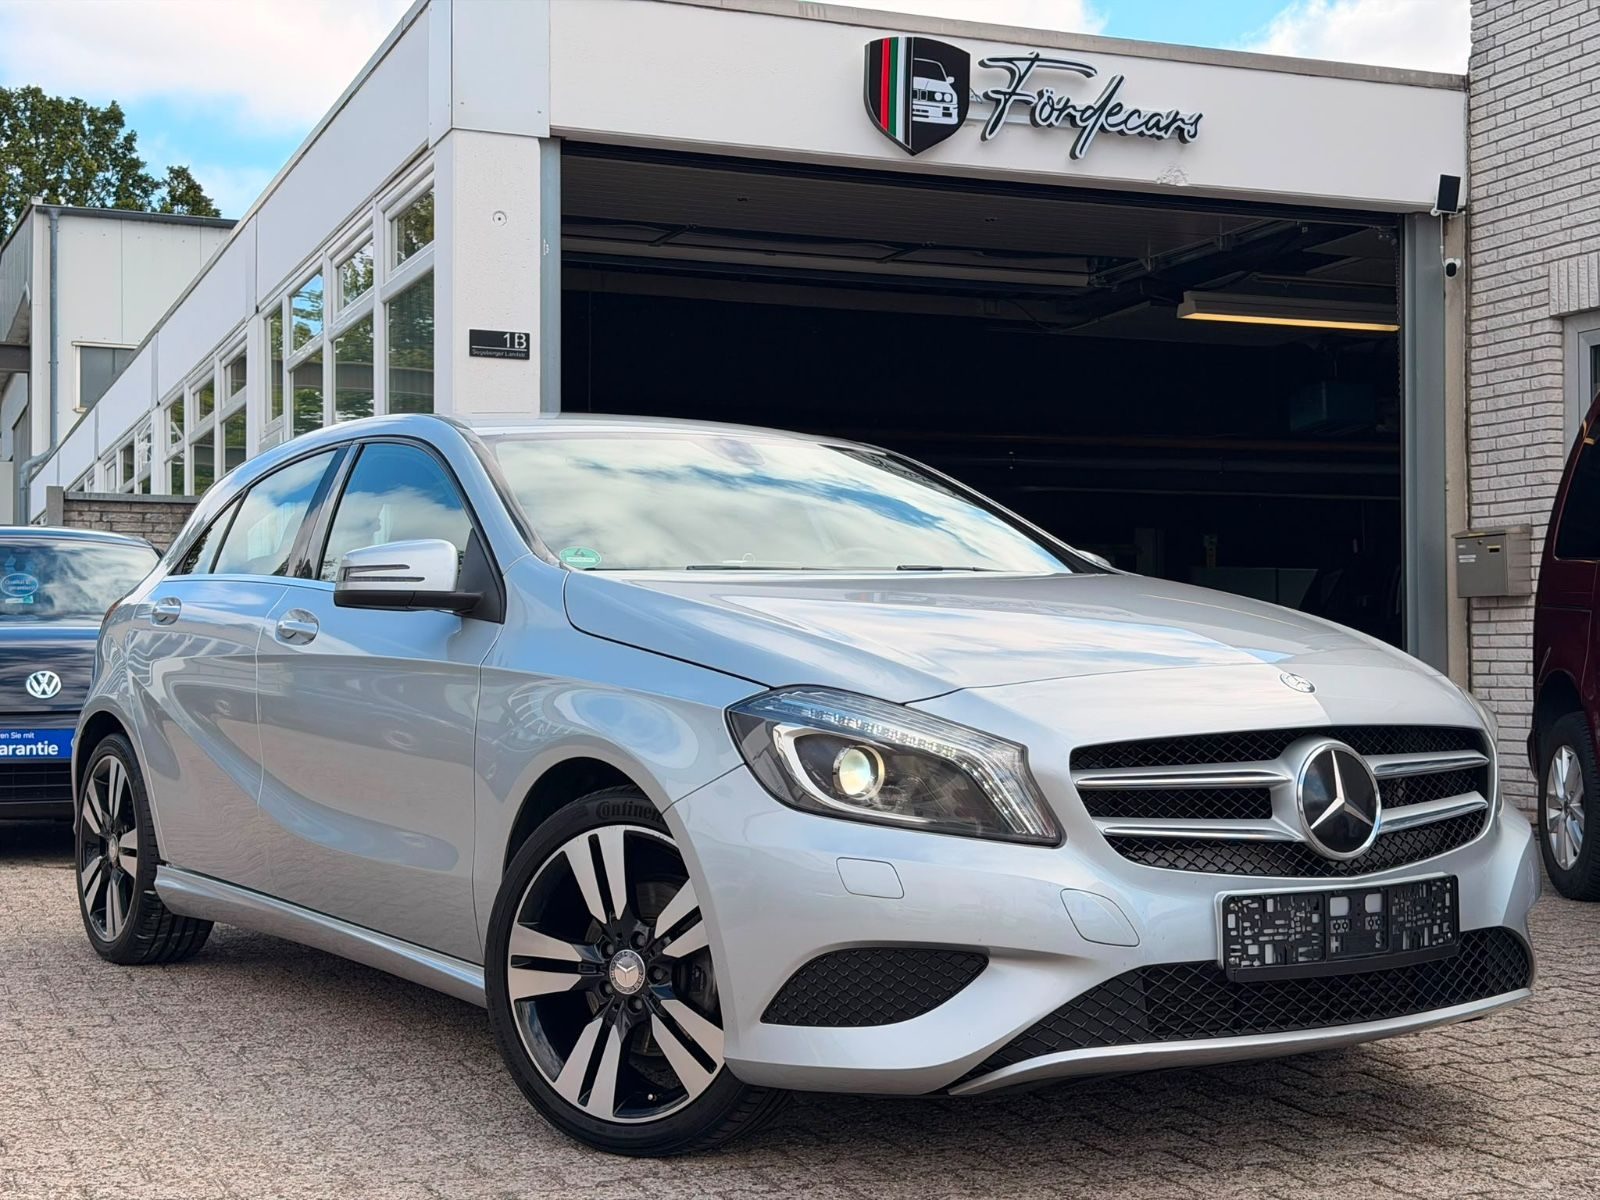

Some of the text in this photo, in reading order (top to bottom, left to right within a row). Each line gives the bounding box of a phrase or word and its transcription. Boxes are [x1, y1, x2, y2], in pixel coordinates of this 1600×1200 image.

[978, 51, 1204, 160] Fördecars
[503, 332, 527, 349] 1B
[10, 731, 22, 739] Sie
[23, 731, 35, 739] mit
[0, 740, 59, 756] arantie
[595, 799, 663, 822] Continen
